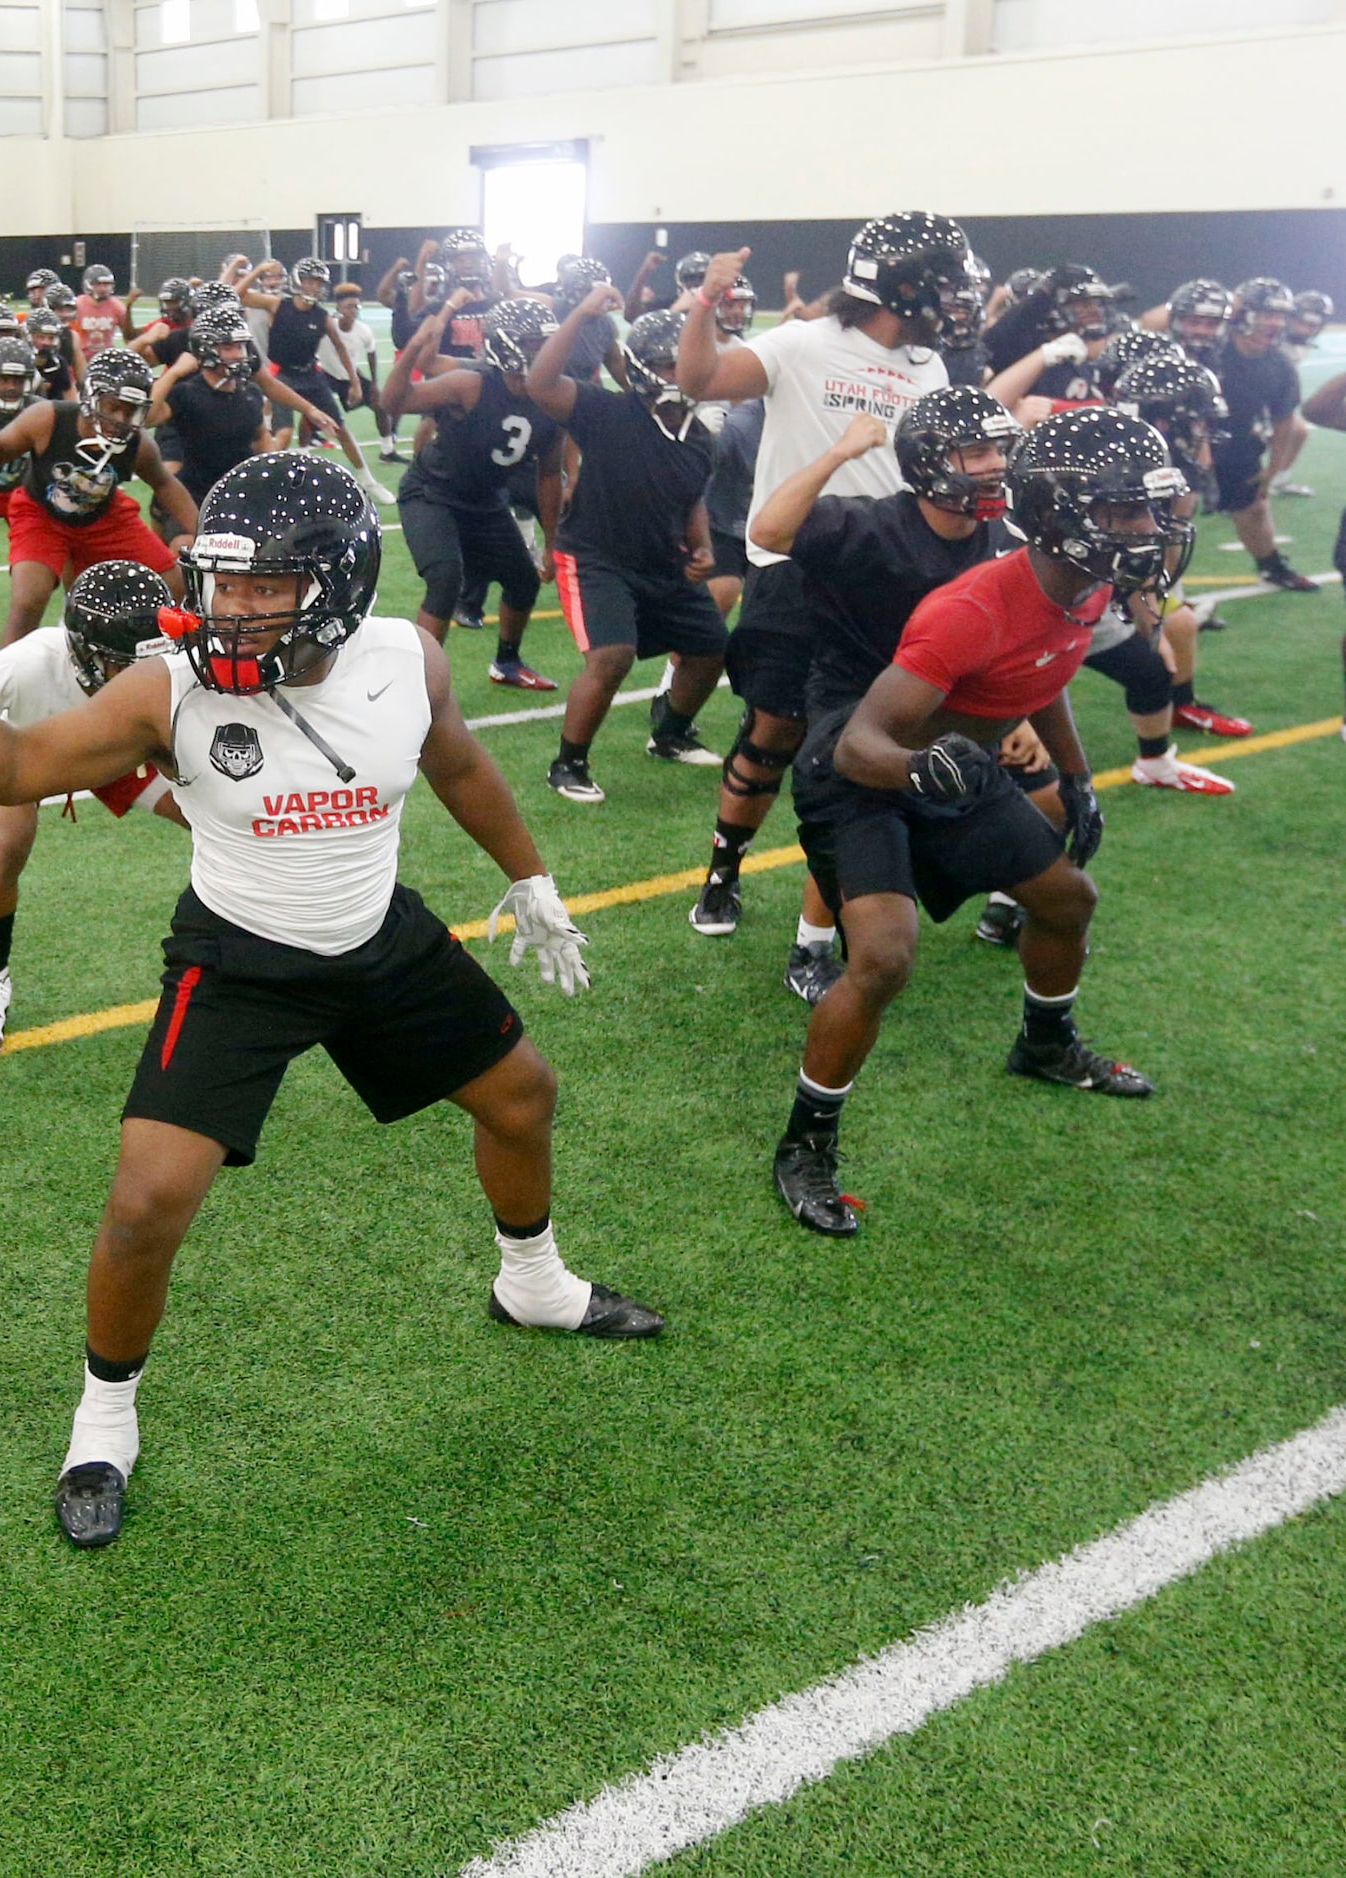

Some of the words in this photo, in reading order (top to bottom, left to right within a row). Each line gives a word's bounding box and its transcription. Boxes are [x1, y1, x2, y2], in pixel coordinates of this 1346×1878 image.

[825, 379, 866, 396] UTAH
[829, 393, 896, 418] SPRING
[491, 414, 532, 466] 3
[209, 537, 240, 550] Riddell
[262, 785, 378, 817] VAPOR
[251, 803, 390, 838] CARBON
